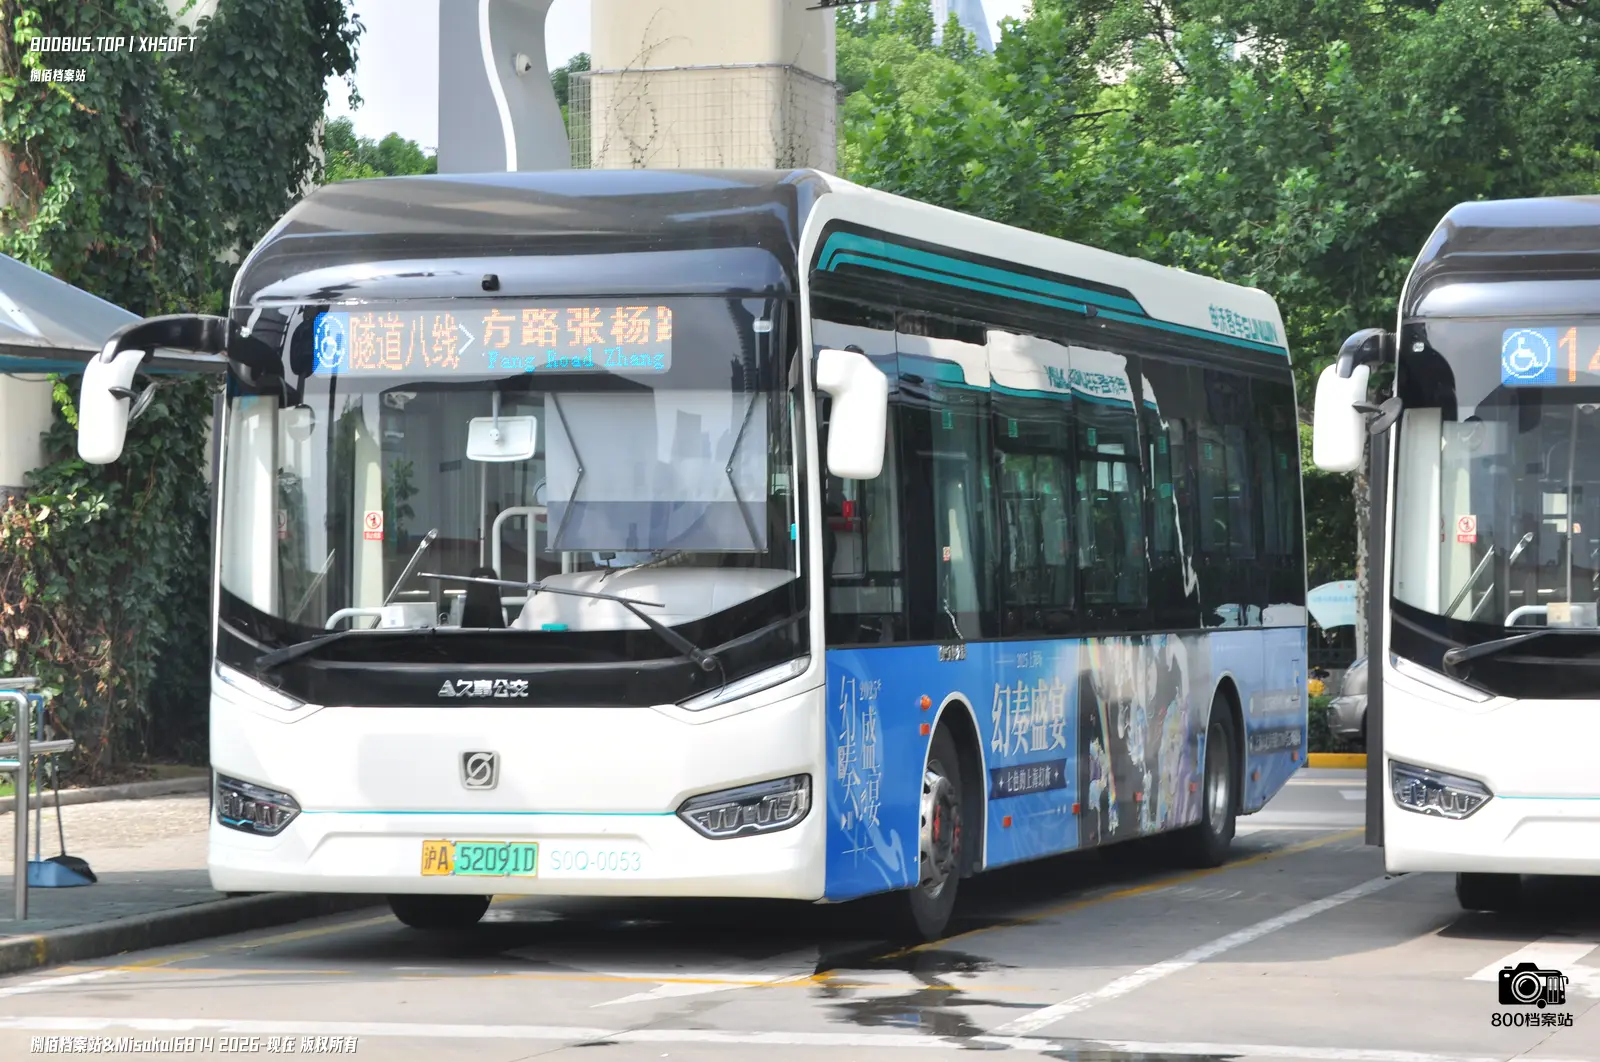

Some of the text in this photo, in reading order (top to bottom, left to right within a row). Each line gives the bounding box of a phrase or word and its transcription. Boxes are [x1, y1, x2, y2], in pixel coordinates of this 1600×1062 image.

[350, 312, 460, 370] 隧道八线
[487, 346, 666, 372] Fang Road Zhang
[456, 678, 529, 698] 久事公交
